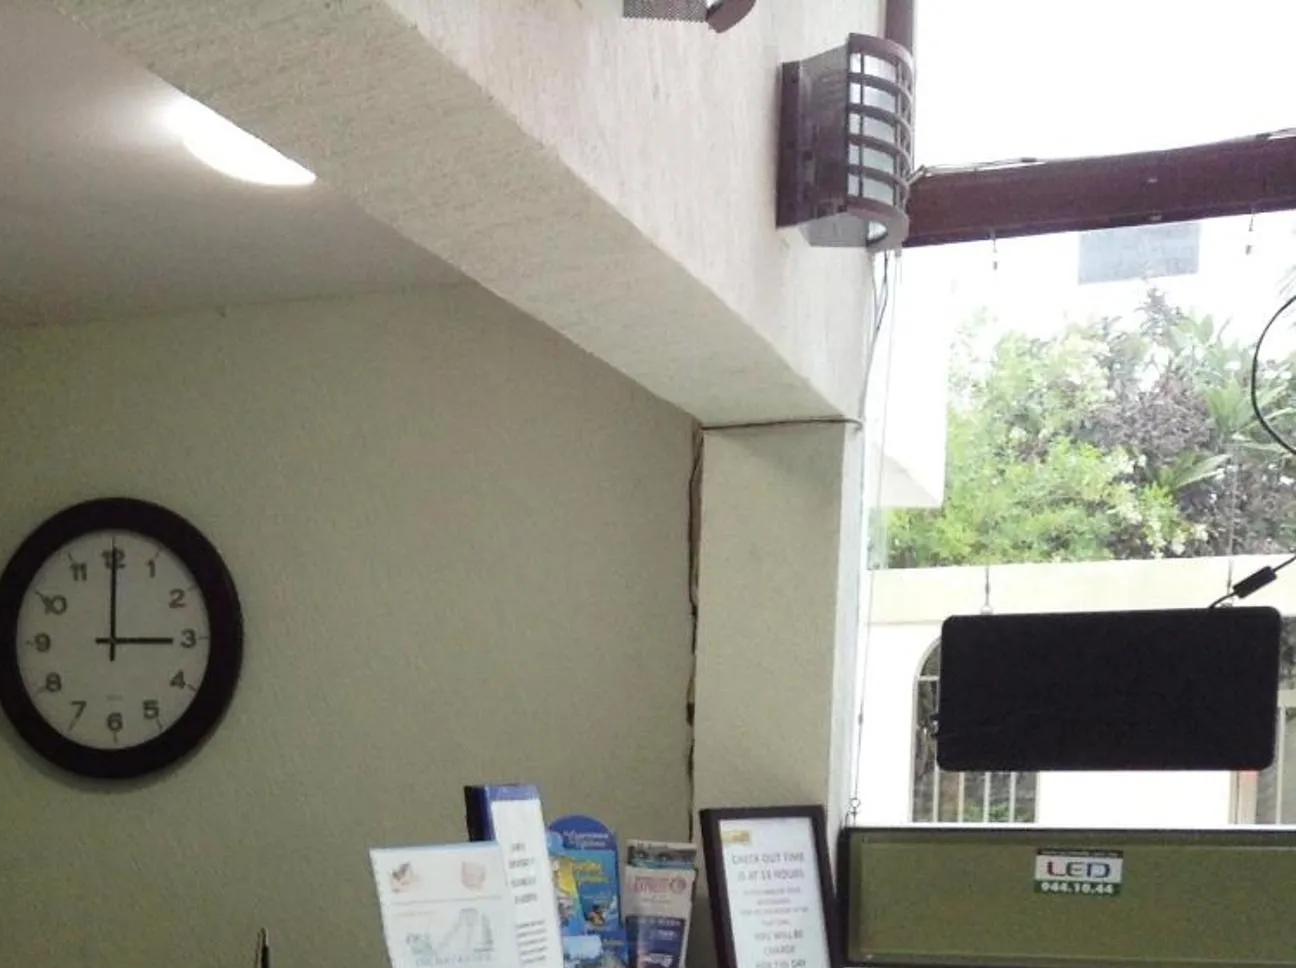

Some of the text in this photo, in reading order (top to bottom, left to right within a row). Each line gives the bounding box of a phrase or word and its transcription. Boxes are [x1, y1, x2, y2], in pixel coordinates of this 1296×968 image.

[70, 563, 87, 582] 11
[146, 559, 155, 578] 1
[43, 595, 68, 615] 10
[168, 588, 186, 608] 2
[35, 633, 51, 652] 9
[180, 629, 196, 648] 3
[45, 672, 62, 692] 8
[169, 671, 185, 689] 4
[70, 700, 87, 719] 7
[143, 701, 159, 719] 5
[107, 713, 123, 732] 6
[1047, 861, 1110, 878] LED
